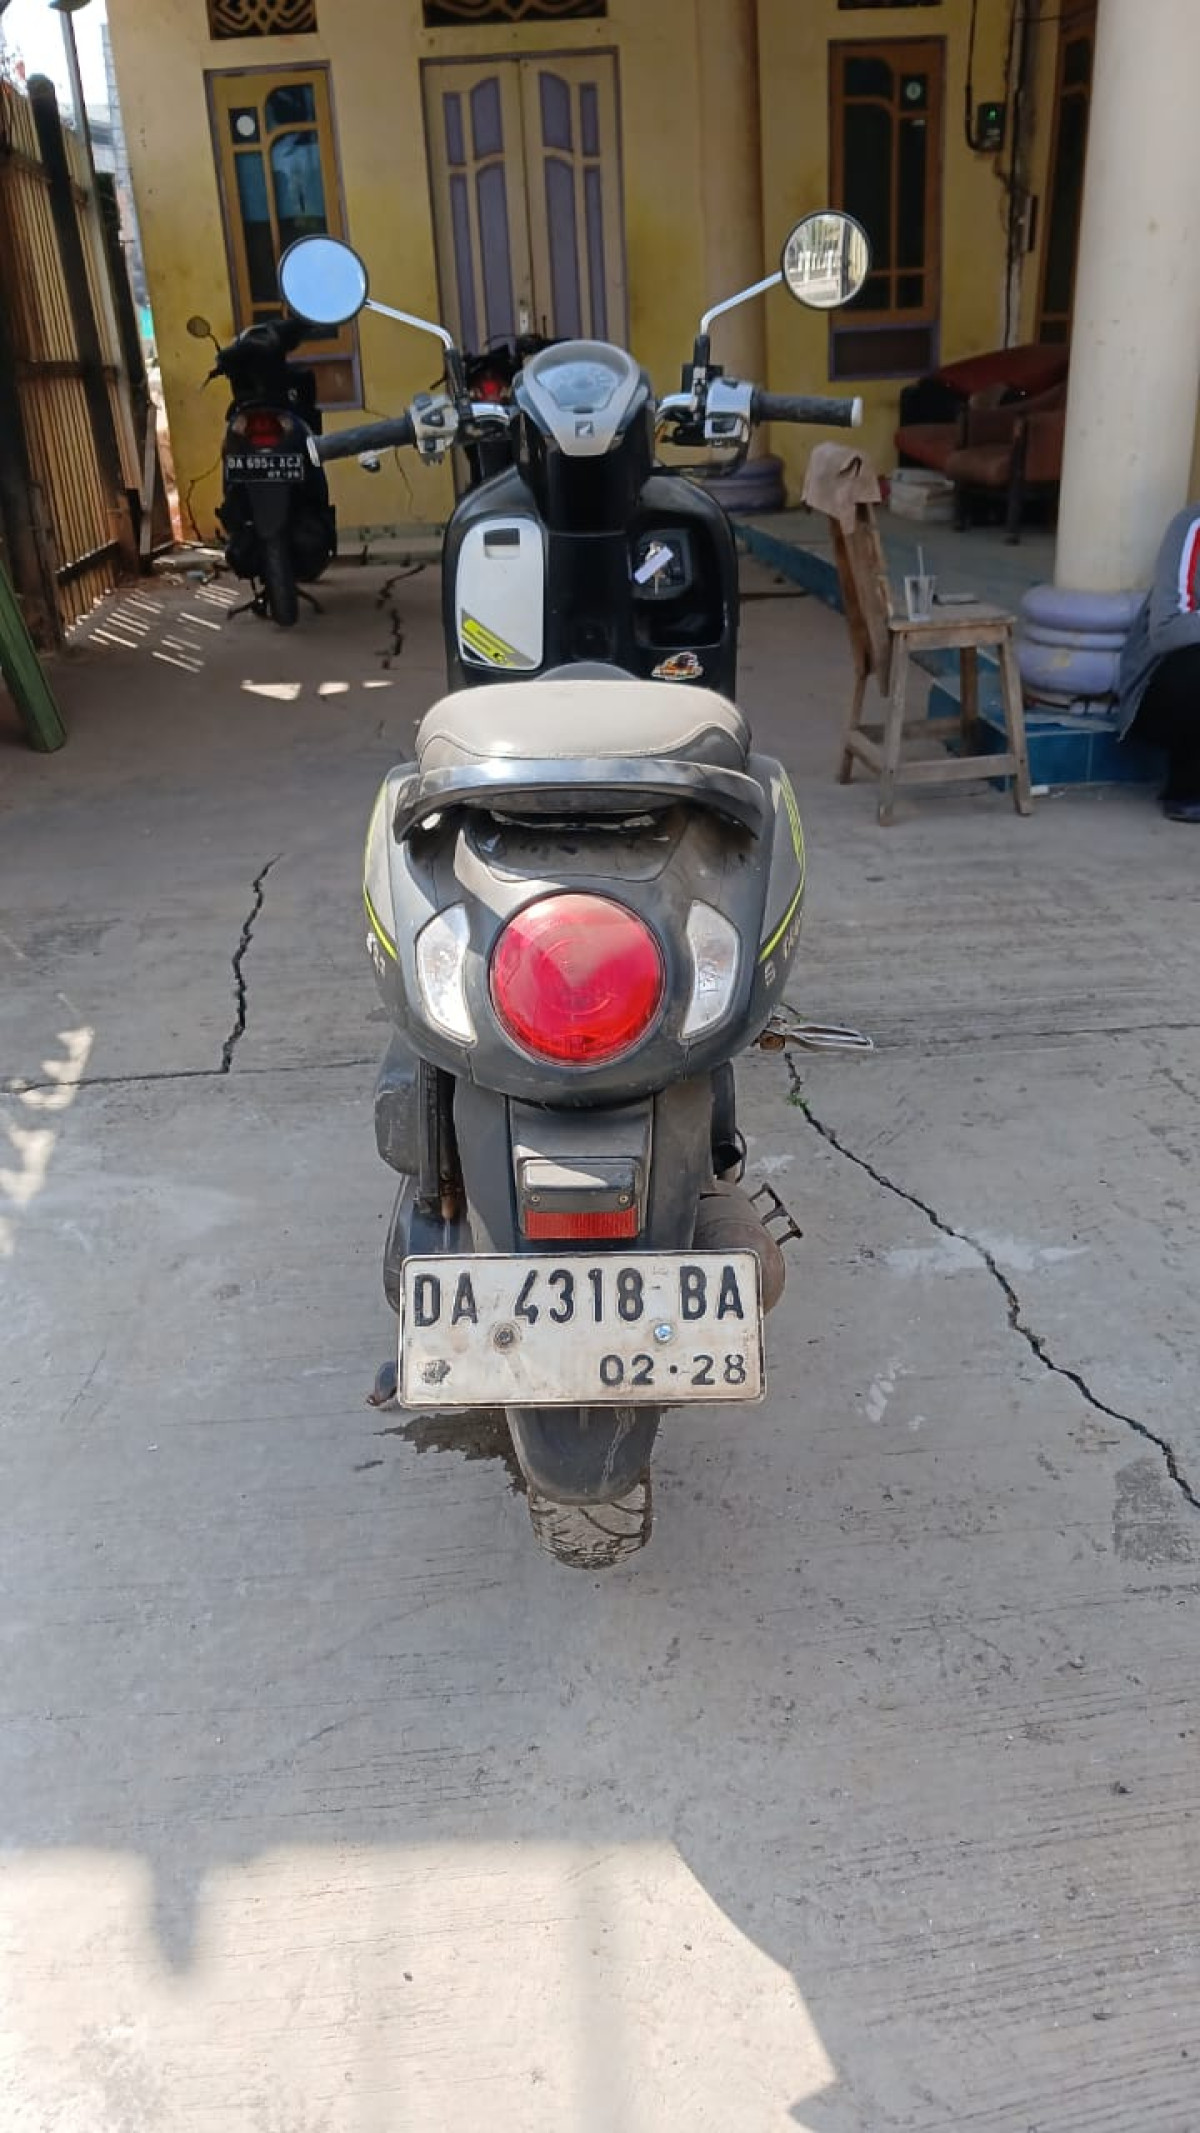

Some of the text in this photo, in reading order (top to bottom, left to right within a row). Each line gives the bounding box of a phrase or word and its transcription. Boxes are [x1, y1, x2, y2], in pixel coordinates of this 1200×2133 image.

[413, 1264, 745, 1327] DA 4318 BA
